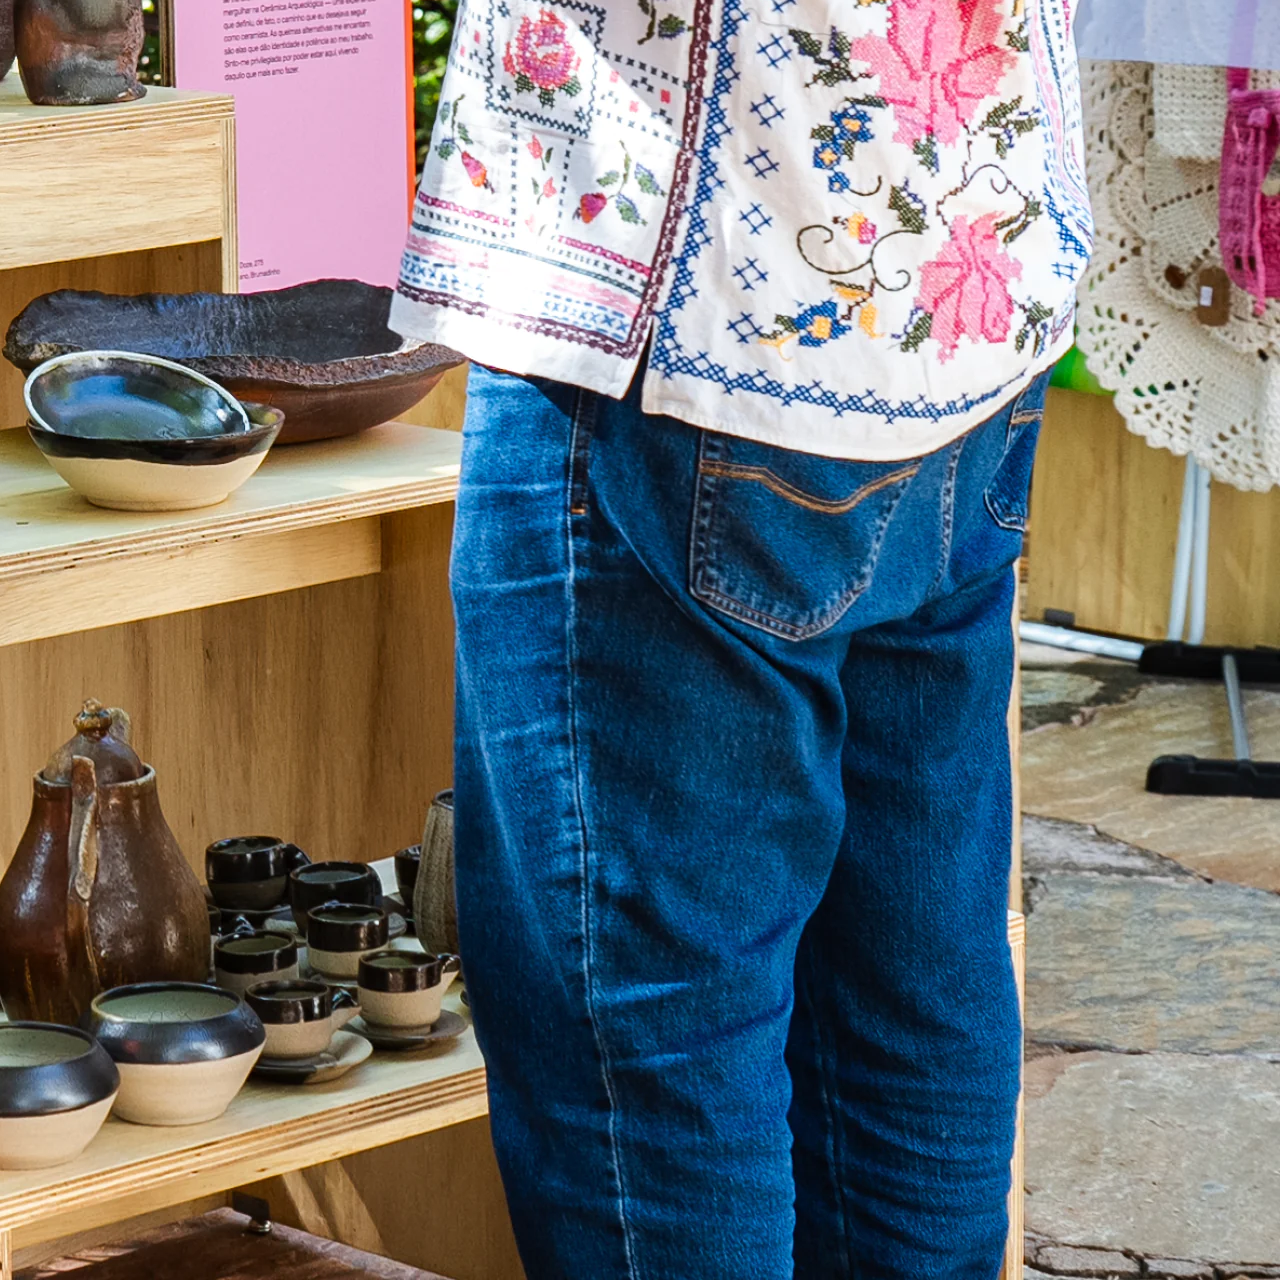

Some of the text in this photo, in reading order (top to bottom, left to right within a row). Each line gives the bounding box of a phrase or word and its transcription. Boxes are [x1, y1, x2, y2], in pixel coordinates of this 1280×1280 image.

[223, 7, 251, 17] mergulhar
[260, 4, 287, 12] Cerâmica
[288, 1, 324, 10] Arqueológica
[281, 15, 305, 23] caminho
[325, 11, 349, 19] desejava
[350, 9, 367, 17] seguir
[278, 28, 301, 37] queimas
[302, 25, 333, 34] alternativas
[224, 47, 235, 55] são
[272, 41, 300, 49] identidade
[305, 38, 329, 47] potência
[224, 60, 249, 68] Sinto-me
[250, 56, 282, 66] privilegiada
[293, 53, 309, 61] poder
[338, 47, 359, 55] vivendo
[224, 72, 245, 81] daquilo
